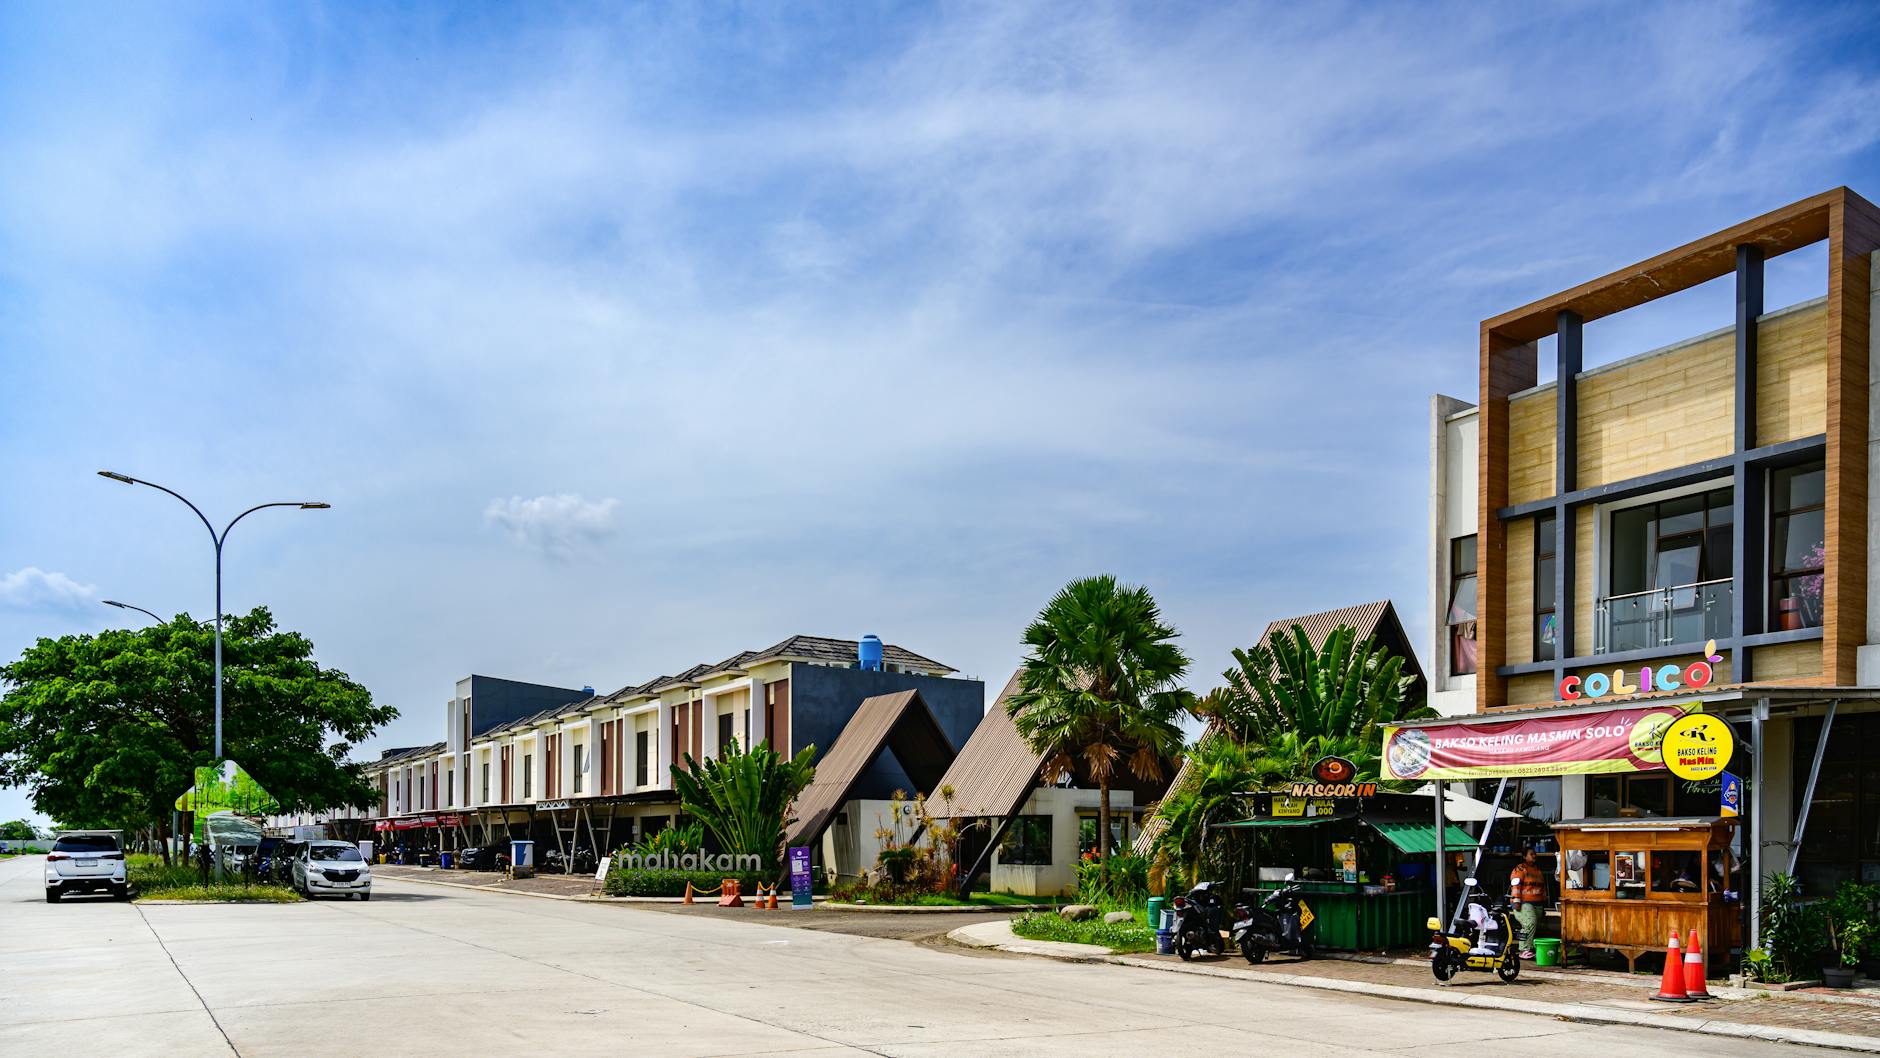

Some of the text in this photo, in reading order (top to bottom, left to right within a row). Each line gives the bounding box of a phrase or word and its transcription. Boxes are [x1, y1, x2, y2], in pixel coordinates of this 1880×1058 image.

[1559, 661, 1713, 700] COLICO
[1435, 725, 1625, 749] BAKSO KELING MASMIN SOLO
[1677, 747, 1717, 756] BAKSO KELING
[618, 847, 762, 872] mahakam
